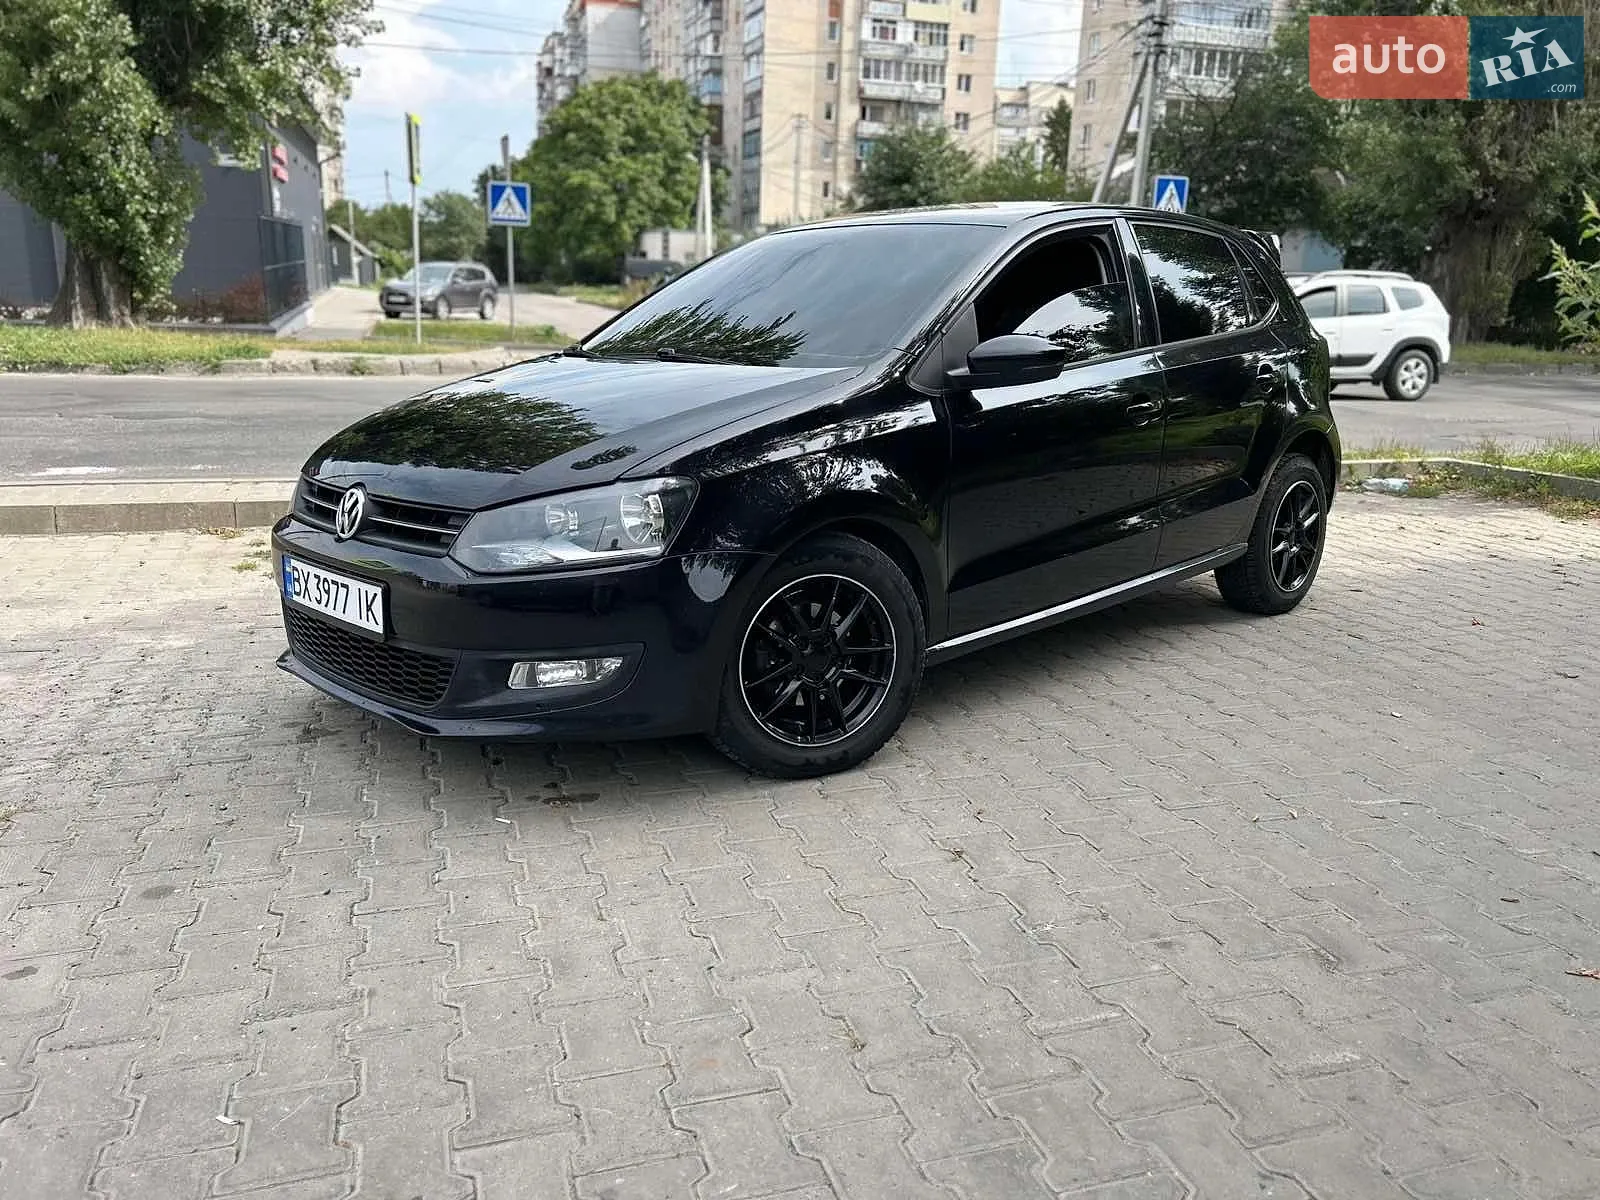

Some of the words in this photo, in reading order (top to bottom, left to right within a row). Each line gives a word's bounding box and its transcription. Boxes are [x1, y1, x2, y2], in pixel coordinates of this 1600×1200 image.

[292, 565, 312, 603] BX
[313, 574, 350, 615] 3977
[358, 587, 380, 626] IK
